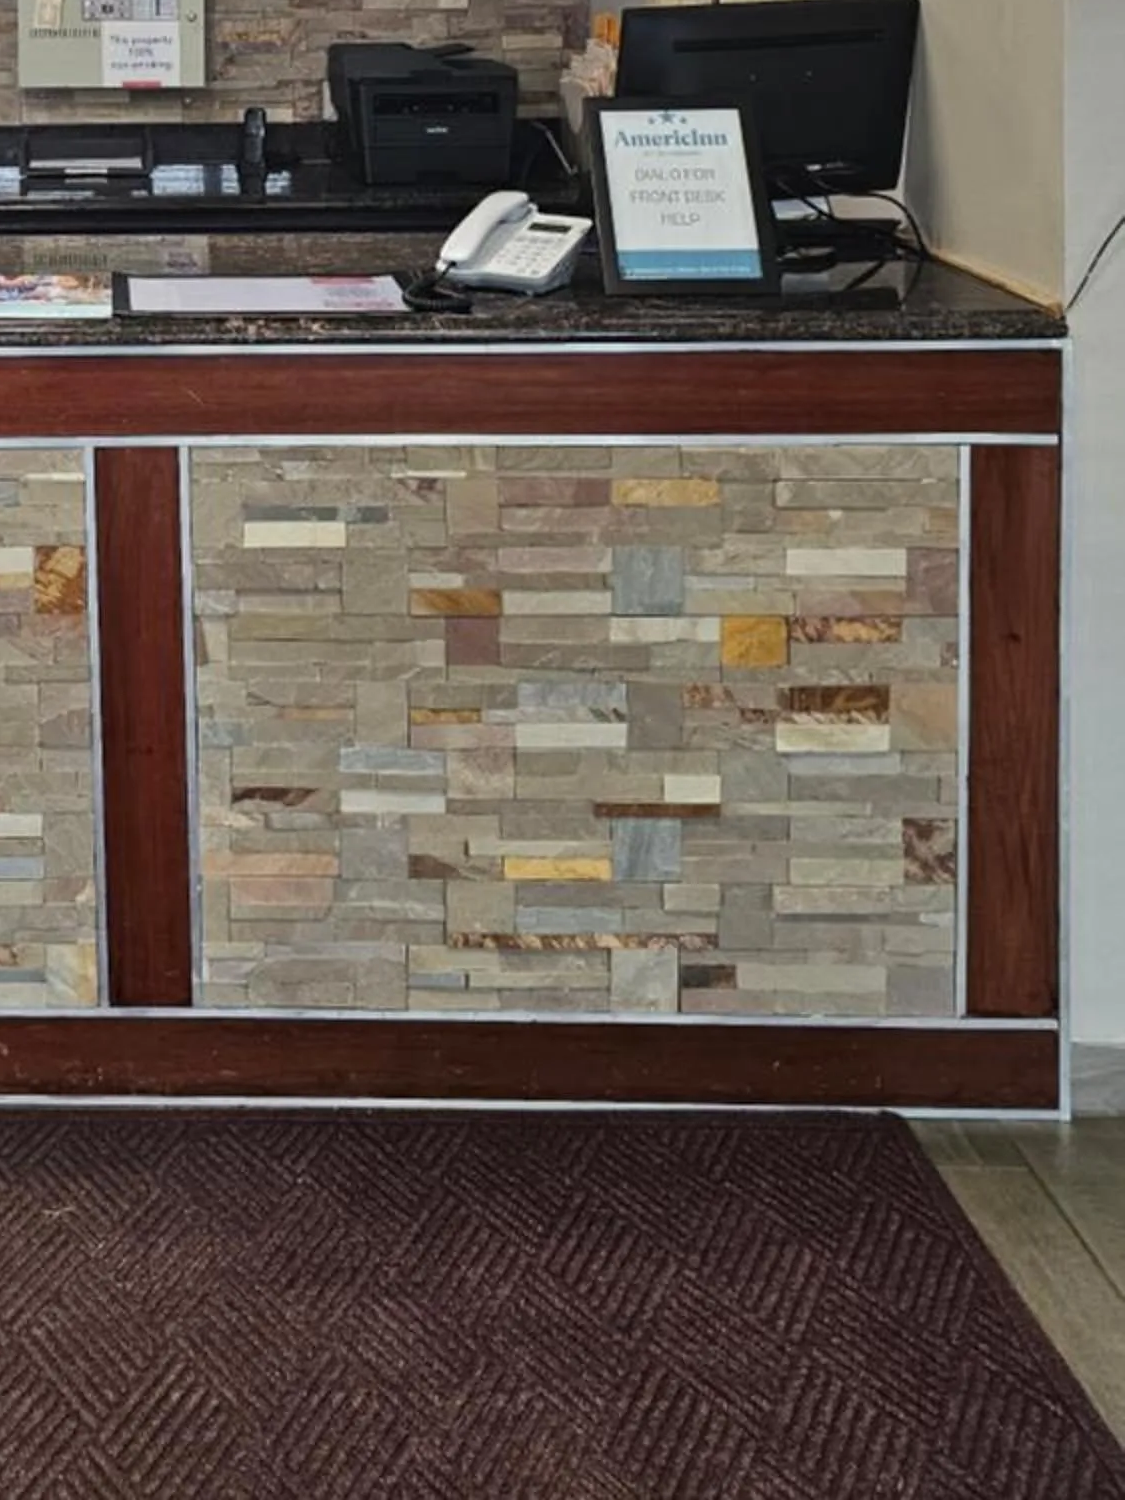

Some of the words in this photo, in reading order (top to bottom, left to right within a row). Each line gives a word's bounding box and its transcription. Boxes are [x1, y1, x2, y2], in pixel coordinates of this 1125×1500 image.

[615, 128, 728, 148] AmericInn
[635, 168, 664, 181] DIAL
[683, 167, 716, 180] FOR
[630, 189, 681, 204] FRONT
[683, 189, 726, 204] DESK
[661, 212, 700, 226] HELP
